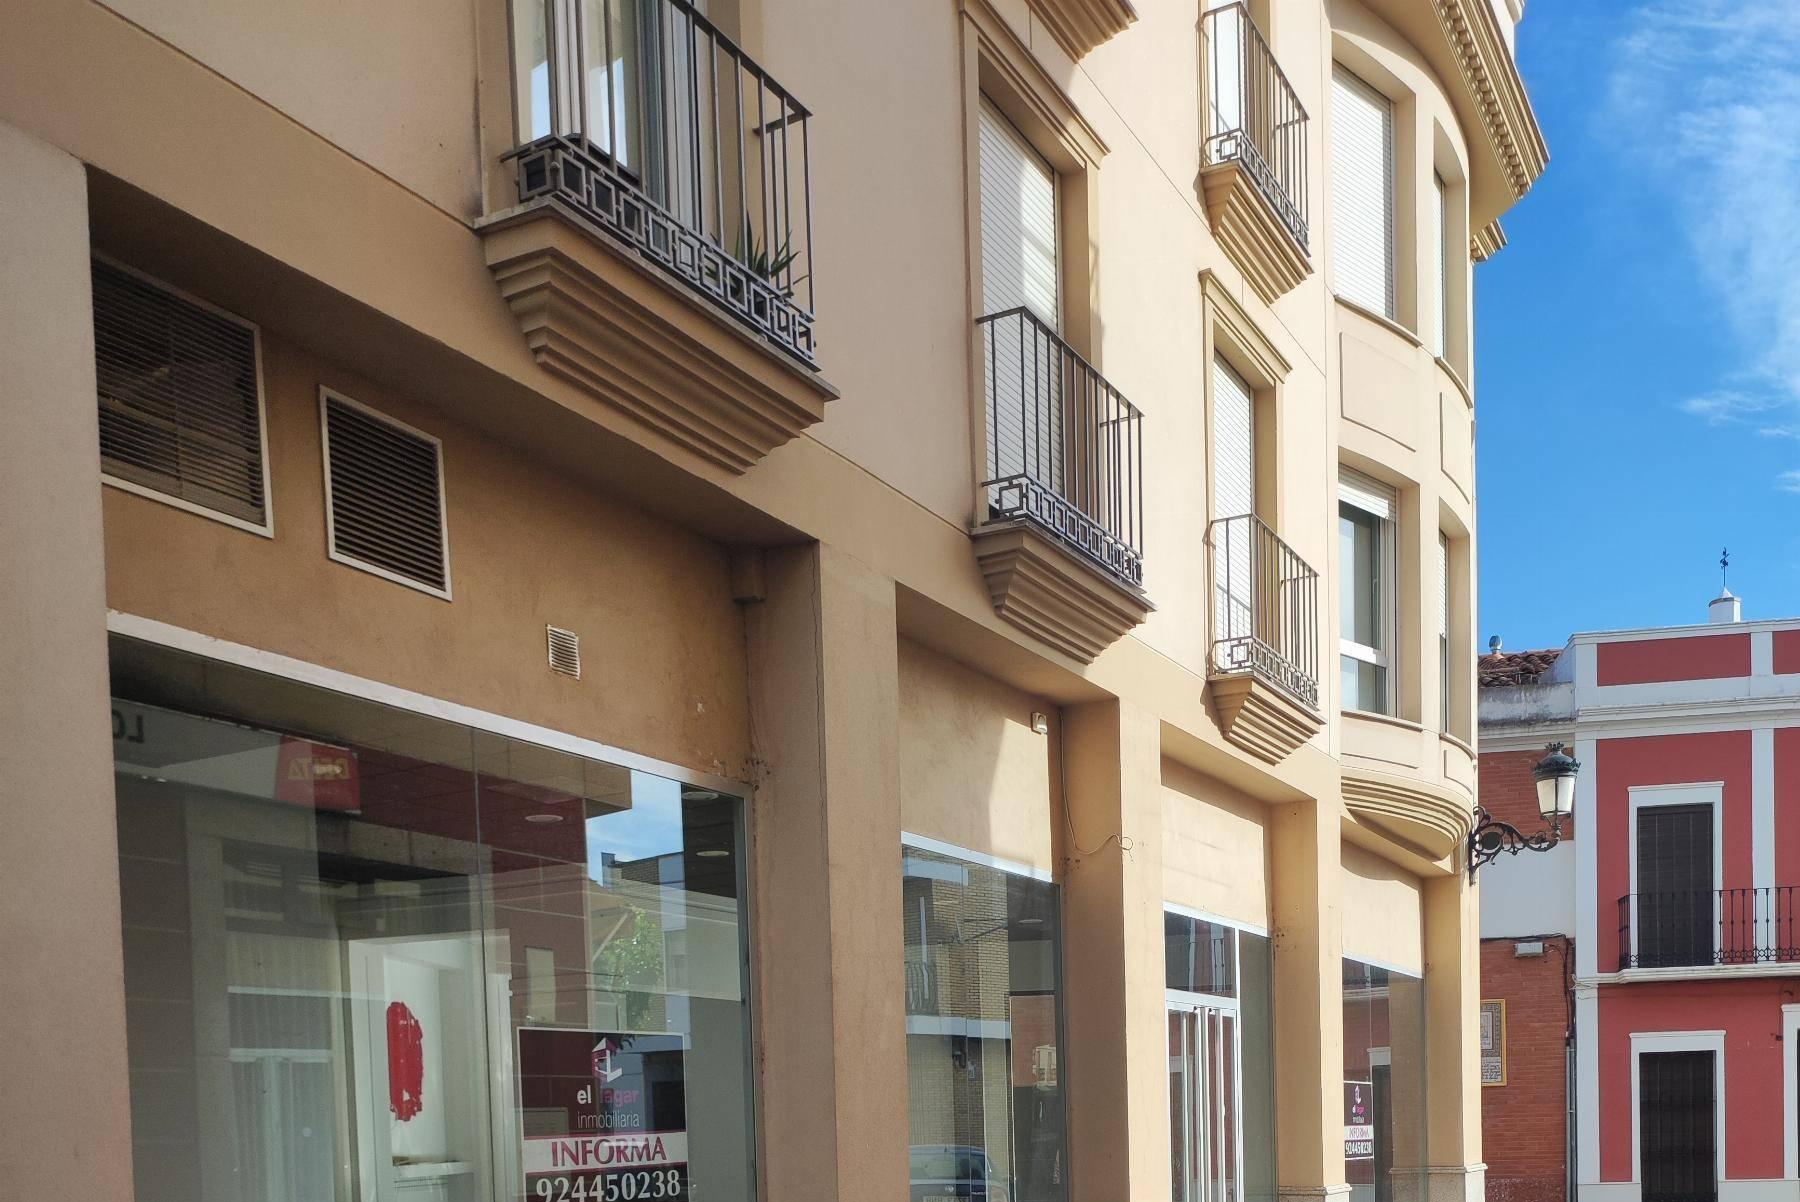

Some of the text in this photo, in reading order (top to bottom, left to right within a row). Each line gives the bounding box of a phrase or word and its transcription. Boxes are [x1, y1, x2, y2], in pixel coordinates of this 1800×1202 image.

[577, 1085, 592, 1104] el
[577, 1111, 640, 1129] inmobiliaria
[551, 1136, 667, 1167] INFORMA
